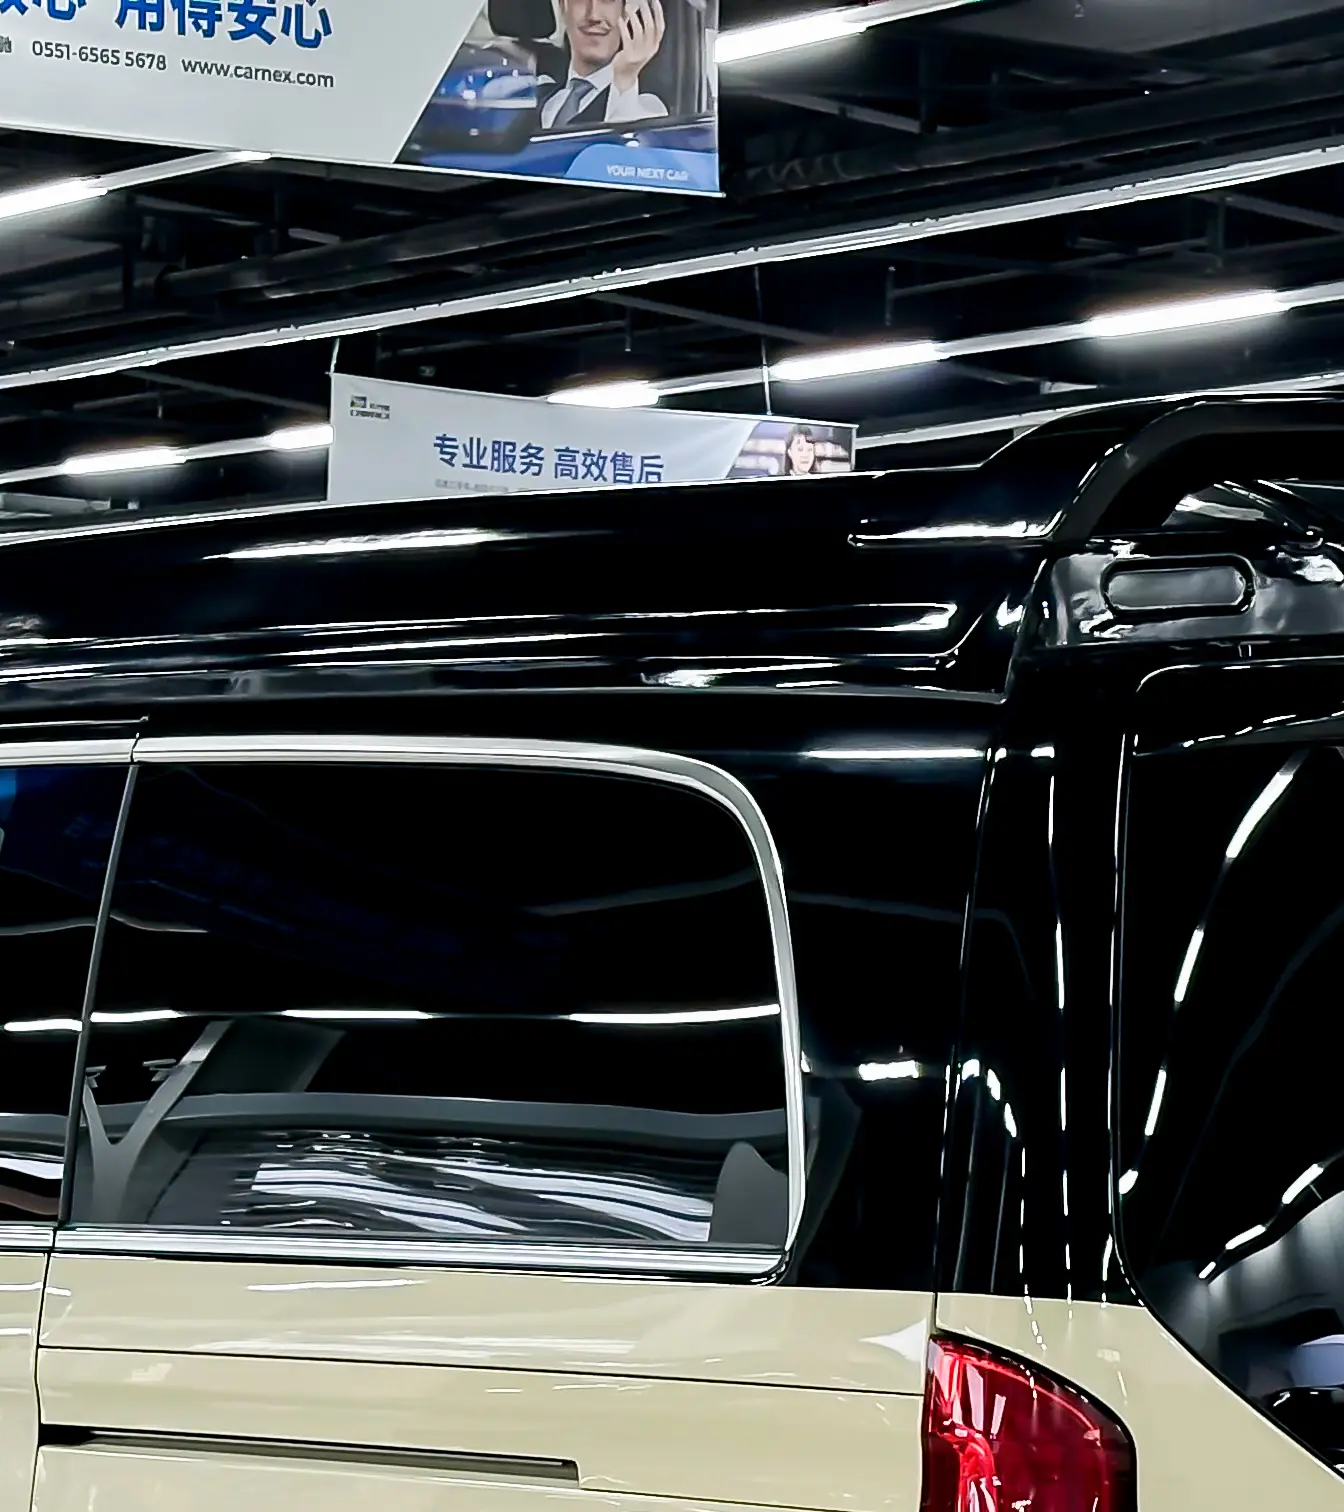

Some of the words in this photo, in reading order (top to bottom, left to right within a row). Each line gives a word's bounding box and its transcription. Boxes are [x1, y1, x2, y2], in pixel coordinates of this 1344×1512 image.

[32, 40, 121, 66] 0551-6565
[124, 50, 167, 71] 5678
[181, 58, 334, 88] www.carnex.com
[606, 165, 636, 177] YOUR
[637, 166, 665, 180] NEXT
[433, 433, 545, 477] 专业服务
[554, 446, 665, 485] 高效售后
